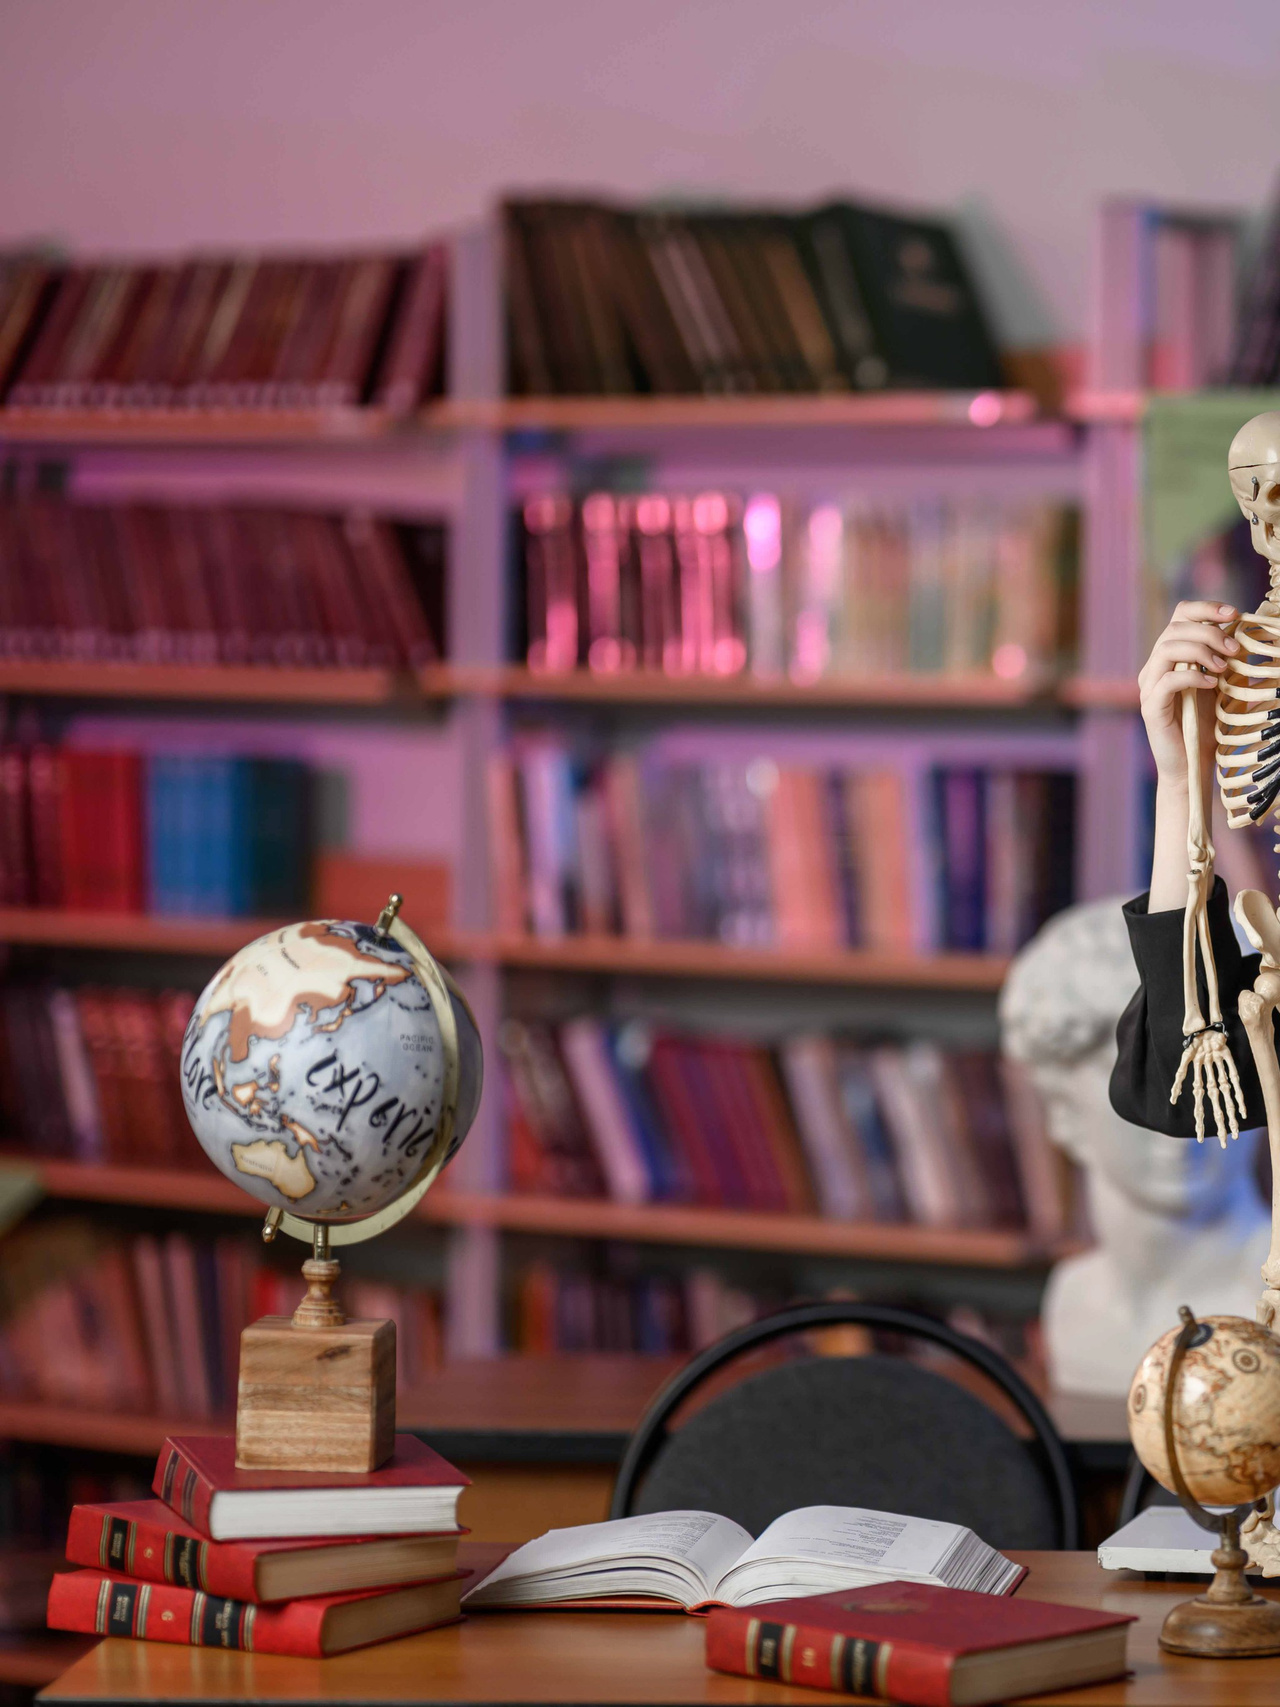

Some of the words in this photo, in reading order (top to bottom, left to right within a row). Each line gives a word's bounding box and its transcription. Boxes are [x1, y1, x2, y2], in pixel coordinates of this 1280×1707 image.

[400, 1034, 434, 1044] PACIFIC
[402, 1042, 433, 1052] OCEAN
[306, 1050, 434, 1158] experie
